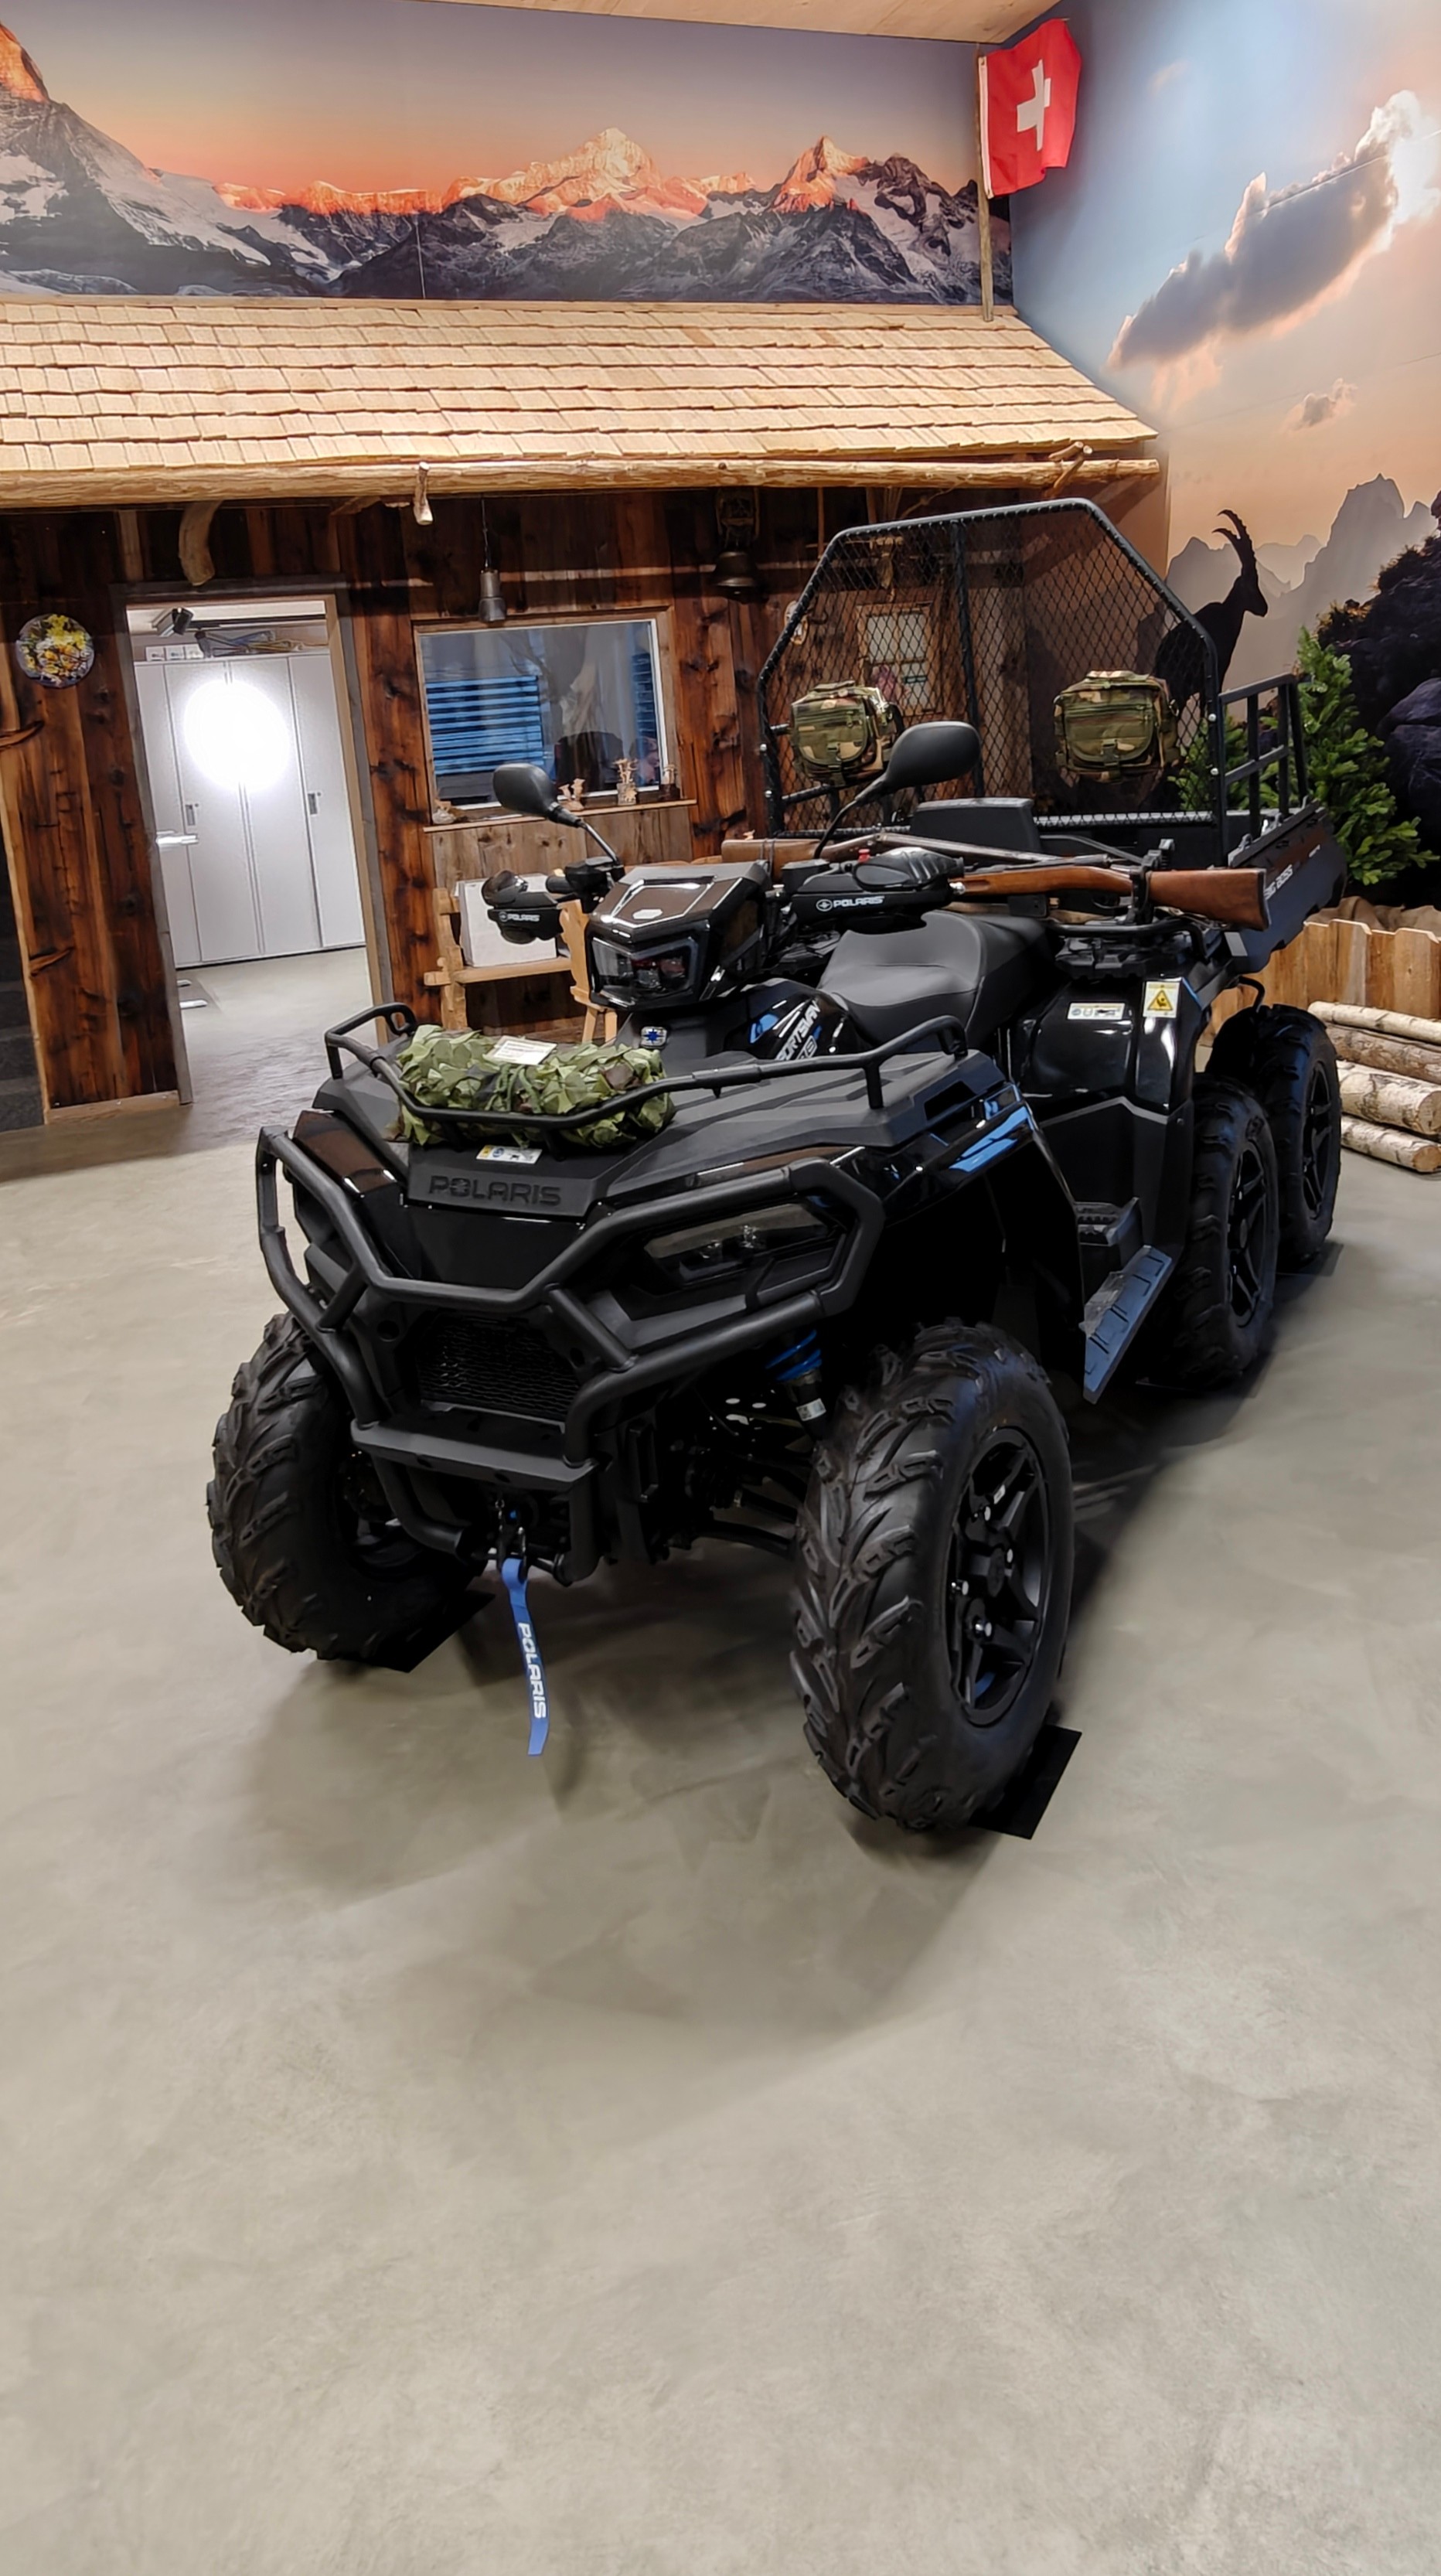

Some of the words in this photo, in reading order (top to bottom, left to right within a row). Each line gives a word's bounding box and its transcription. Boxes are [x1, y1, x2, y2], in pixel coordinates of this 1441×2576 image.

[1276, 864, 1293, 889] BOSS
[833, 895, 885, 908] POLARIS
[507, 913, 540, 922] POLARIS
[775, 1000, 821, 1060] PORTSMAN
[428, 1174, 561, 1207] POLARIS
[517, 1622, 547, 1719] POLARIS
